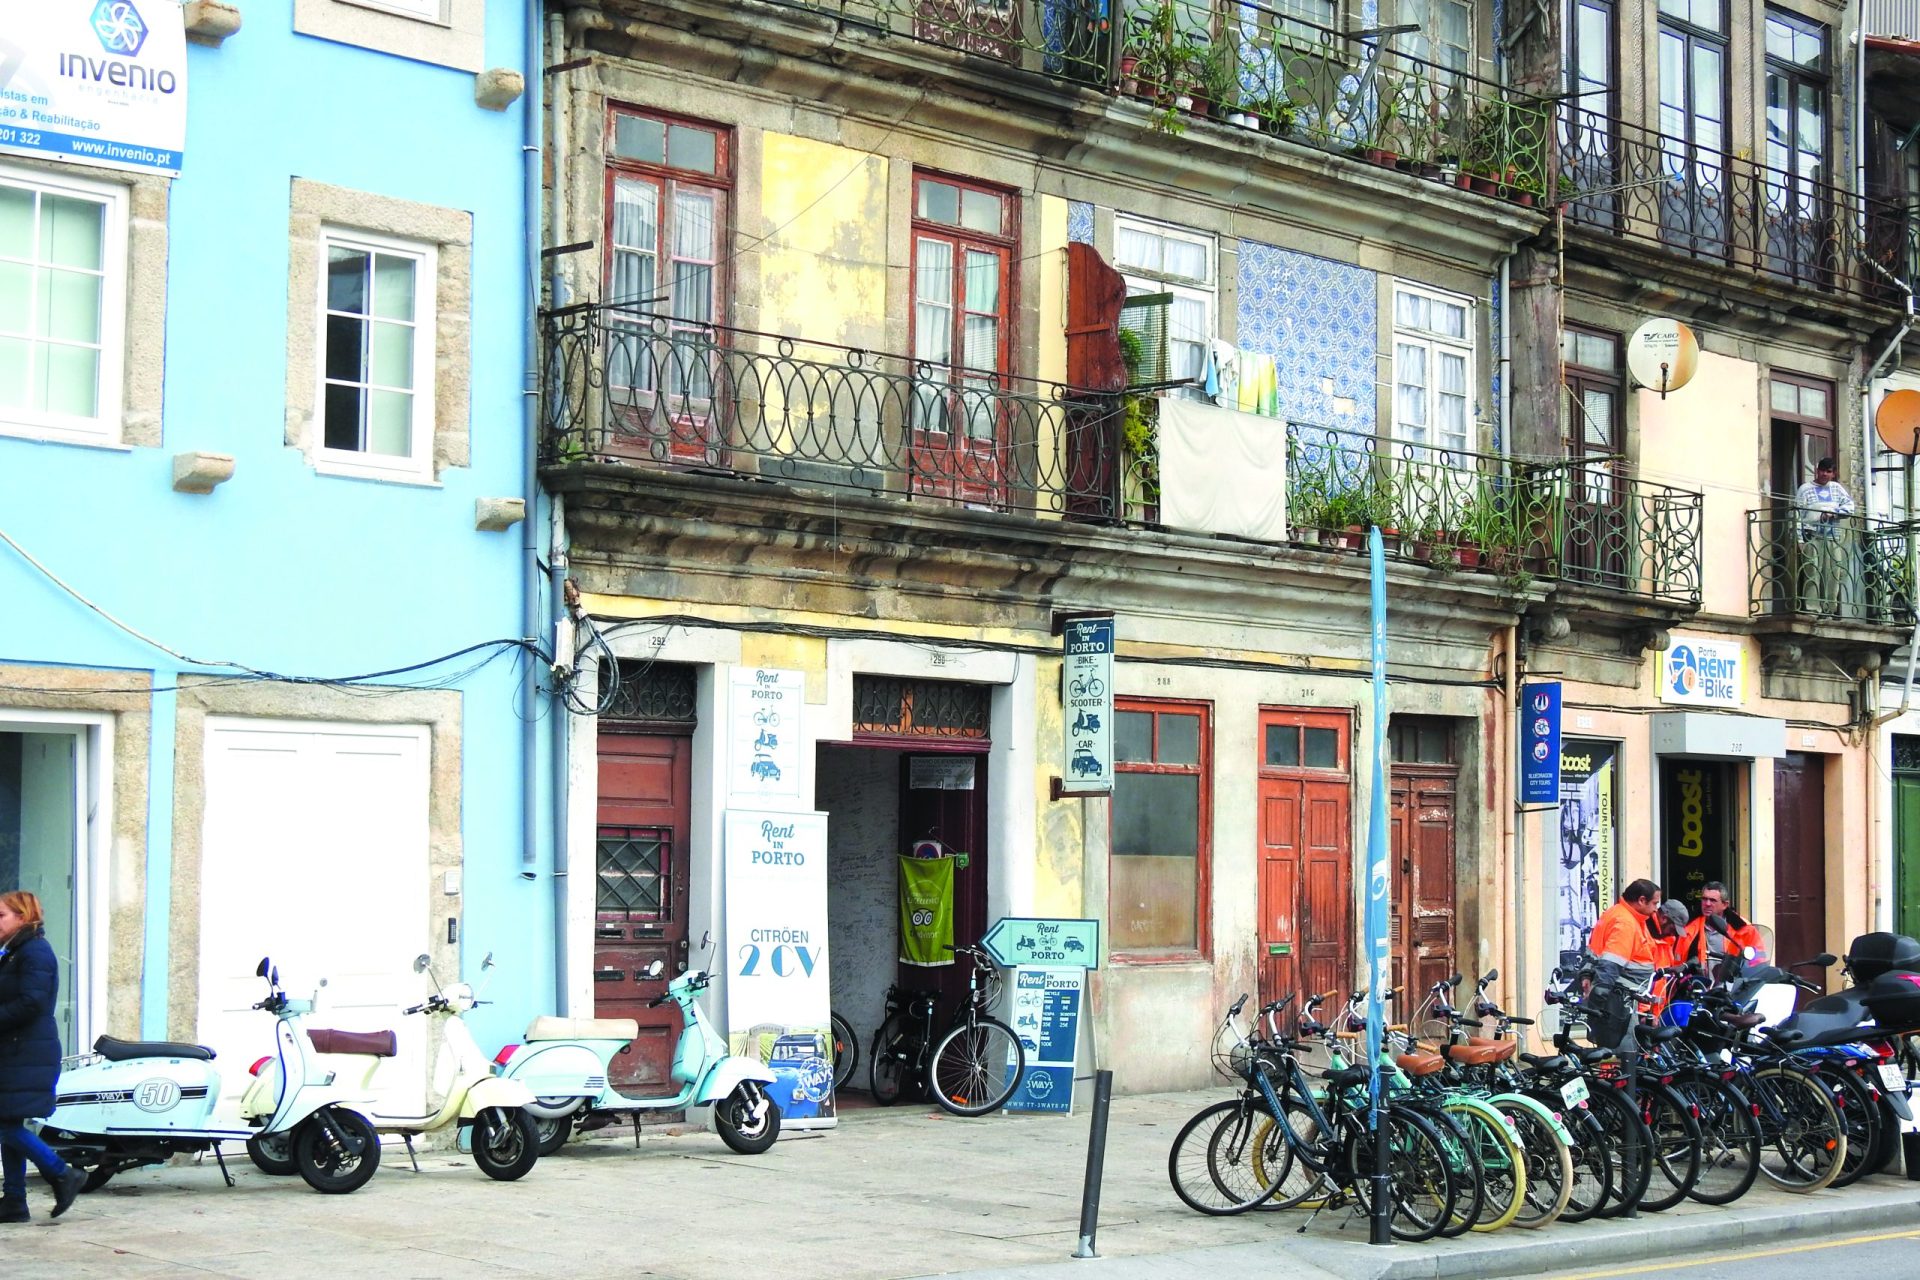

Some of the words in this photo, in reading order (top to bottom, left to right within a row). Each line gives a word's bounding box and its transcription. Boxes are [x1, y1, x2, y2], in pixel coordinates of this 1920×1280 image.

[31, 95, 48, 106] em
[20, 108, 28, 120] &
[32, 110, 101, 131] Reabilitação
[20, 131, 41, 146] 322
[72, 140, 171, 165] www.invenio.pt
[1076, 623, 1097, 637] Rent
[651, 636, 666, 646] 292
[1070, 642, 1105, 653] PORTO
[1698, 646, 1717, 657] Porto
[1077, 655, 1094, 665] BIKE
[1698, 657, 1736, 680] RENT
[755, 669, 779, 686] Rent
[751, 689, 783, 700] PORTO
[1699, 678, 1704, 688] a
[1705, 678, 1733, 699] Bike
[1070, 698, 1103, 708] SCOOTER
[1078, 739, 1093, 749] CAR
[1561, 752, 1591, 772] boost
[1677, 768, 1703, 858] boost
[761, 820, 795, 842] Rent
[773, 841, 784, 849] IN
[752, 850, 805, 866] PORTO
[751, 926, 809, 943] CITRÖEN
[1037, 922, 1060, 935] Rent
[1031, 951, 1065, 960] PORTO
[1020, 973, 1045, 987] Rent
[1046, 980, 1079, 988] PORTO
[140, 1082, 174, 1106] 50
